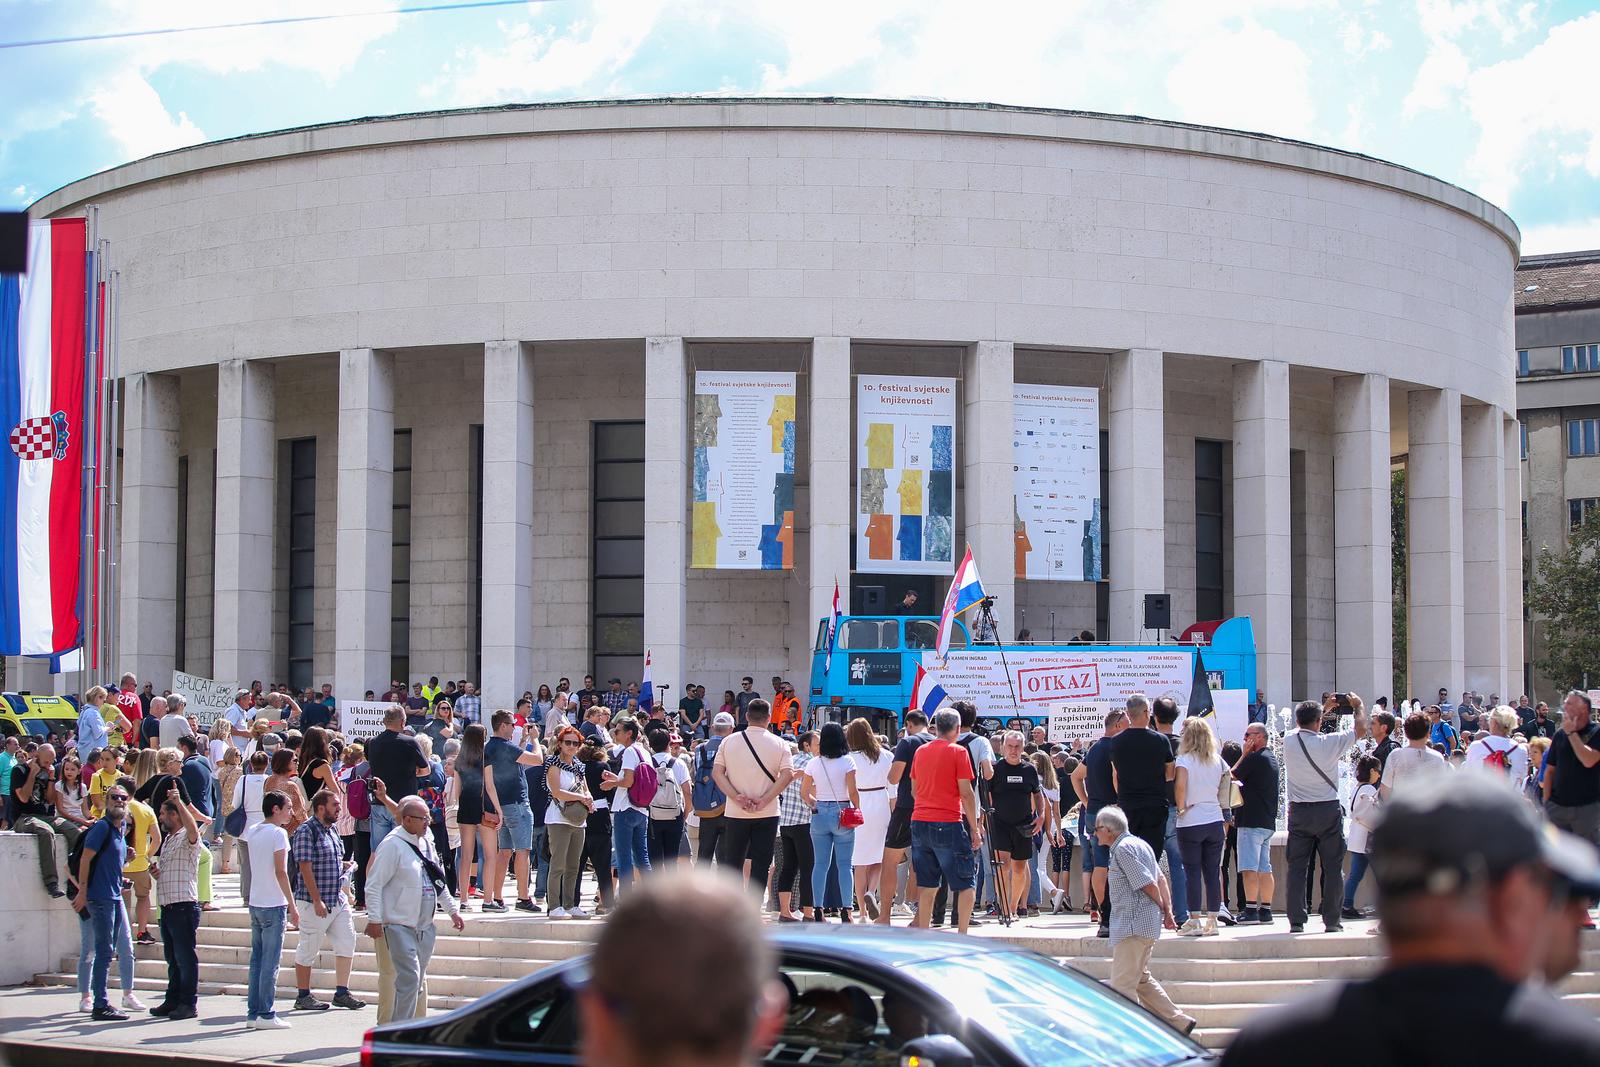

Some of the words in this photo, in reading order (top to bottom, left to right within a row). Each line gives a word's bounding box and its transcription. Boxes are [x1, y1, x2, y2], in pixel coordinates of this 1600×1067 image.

[879, 384, 912, 392] festival
[914, 385, 950, 394] svjetske
[880, 395, 933, 405] književnosti
[1027, 672, 1092, 692] OTKAZ
[1062, 705, 1097, 713] Tražimo
[1054, 713, 1104, 723] raspisivanje
[1054, 722, 1103, 731] izvanrednih
[1064, 731, 1093, 739] izbora!
